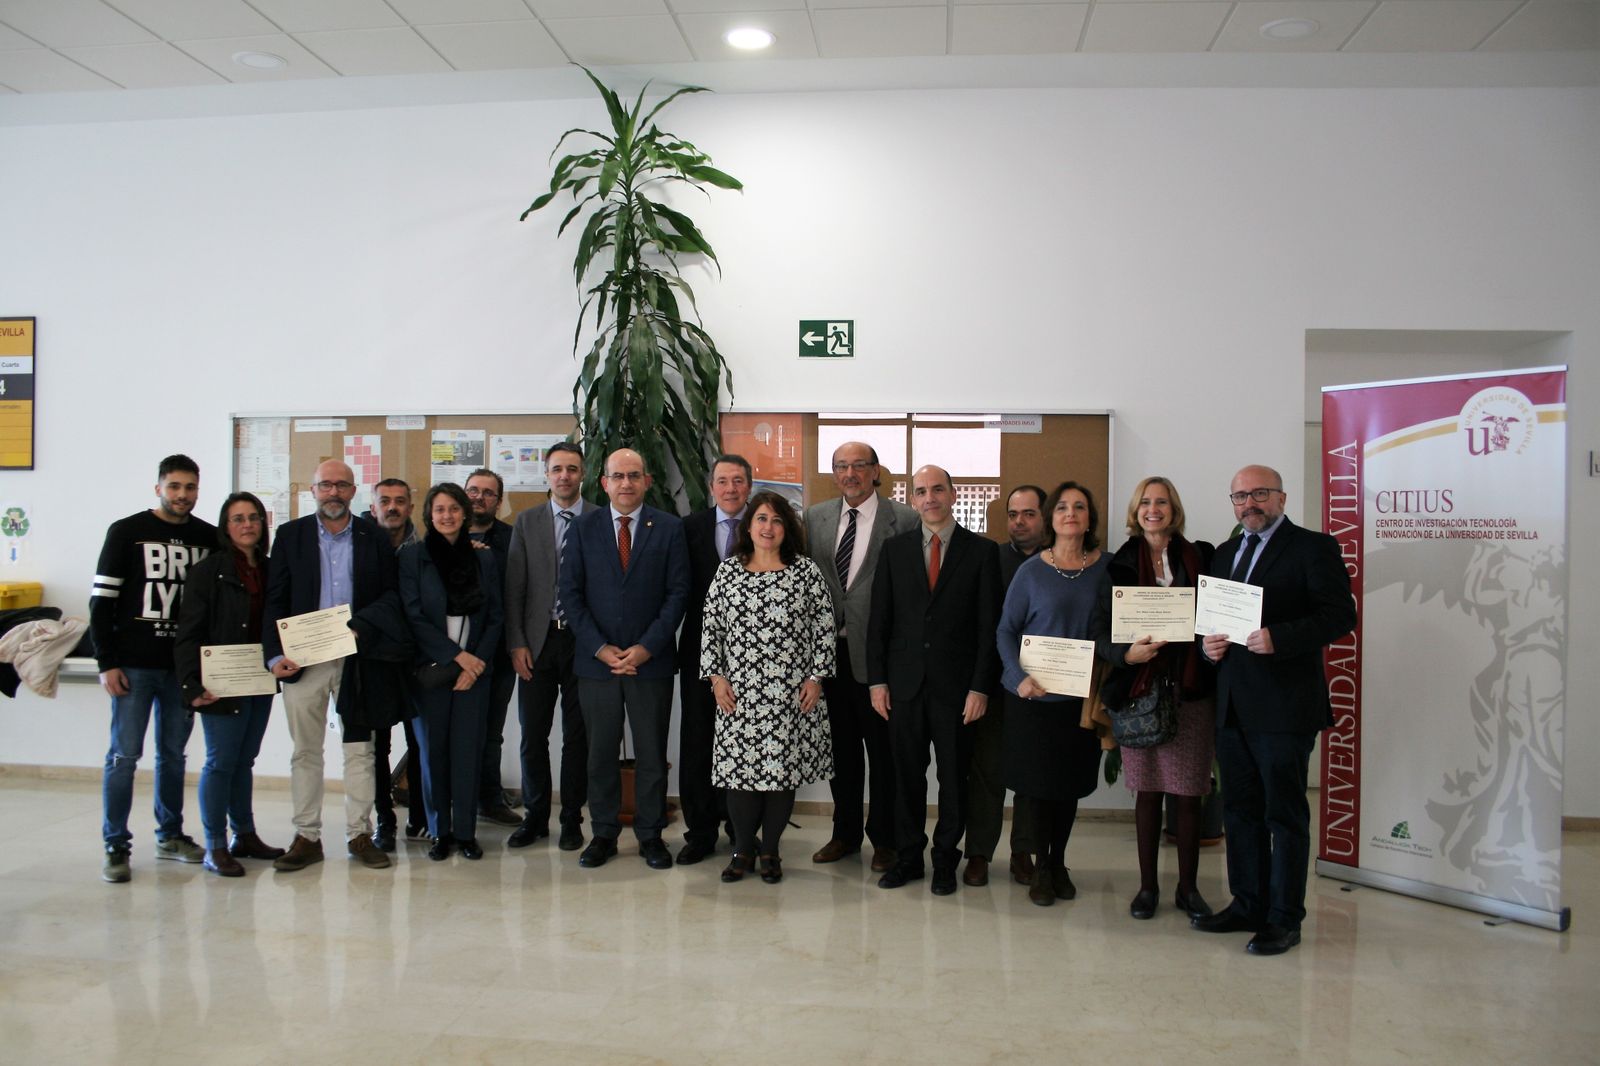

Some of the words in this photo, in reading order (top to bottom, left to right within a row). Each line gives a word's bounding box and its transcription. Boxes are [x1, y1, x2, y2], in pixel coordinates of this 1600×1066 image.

[1465, 393, 1518, 427] UNIVERSIDAD
[1375, 489, 1454, 514] CITIUS
[1375, 519, 1403, 528] CENTRO
[1404, 519, 1414, 528] DE
[1415, 518, 1468, 528] INVESTIGACIÓN
[1469, 517, 1517, 528] TECNOLOGÍA
[1375, 530, 1381, 539] E
[1423, 530, 1433, 539] DE
[1434, 530, 1444, 539] LA
[1445, 530, 1493, 540] UNIVERSIDAD
[1494, 530, 1505, 540] DE
[1506, 530, 1538, 540] SEVILLA
[141, 582, 184, 619] LY
